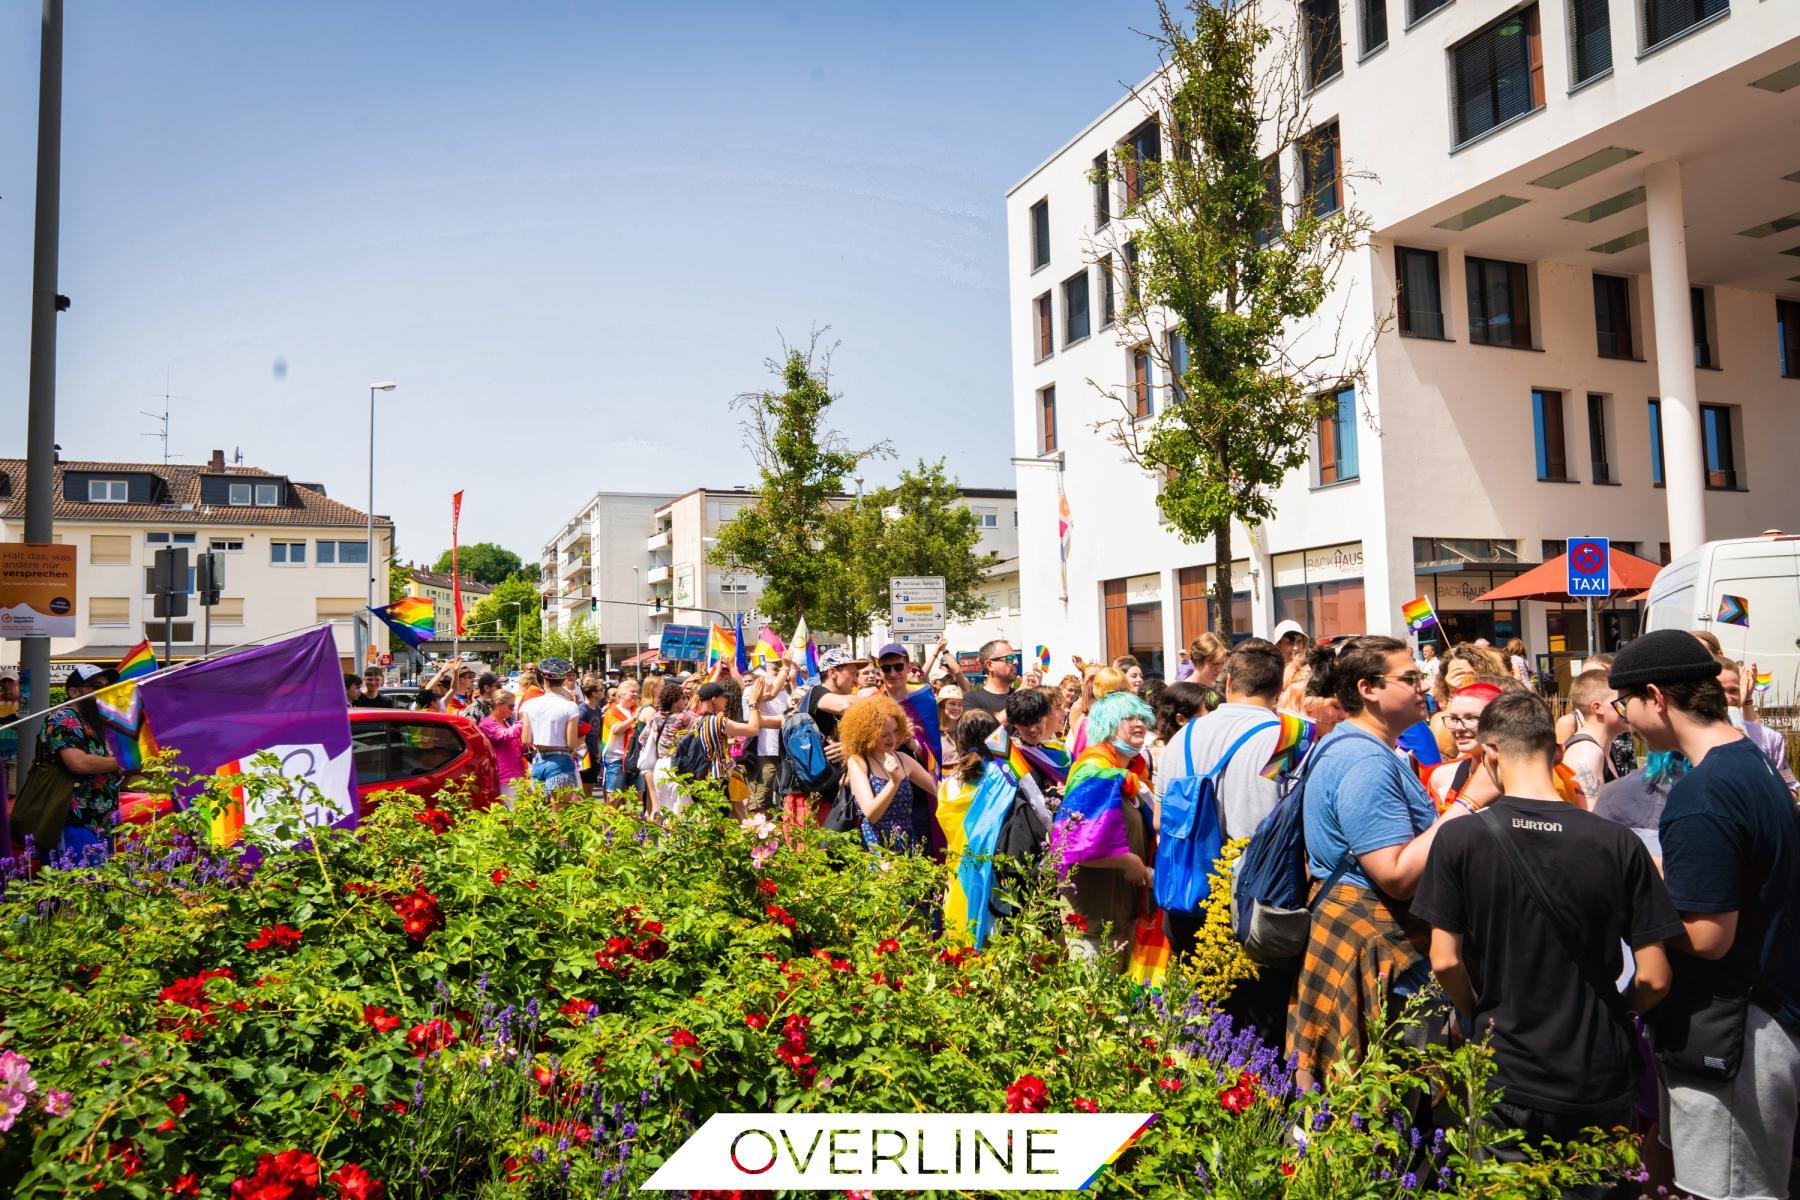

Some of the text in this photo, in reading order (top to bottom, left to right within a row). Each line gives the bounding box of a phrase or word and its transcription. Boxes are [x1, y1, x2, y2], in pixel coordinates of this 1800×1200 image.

[3, 561, 41, 569] andere
[3, 570, 69, 578] versprechen
[1572, 577, 1605, 591] TAXI
[1512, 818, 1563, 832] BURTON
